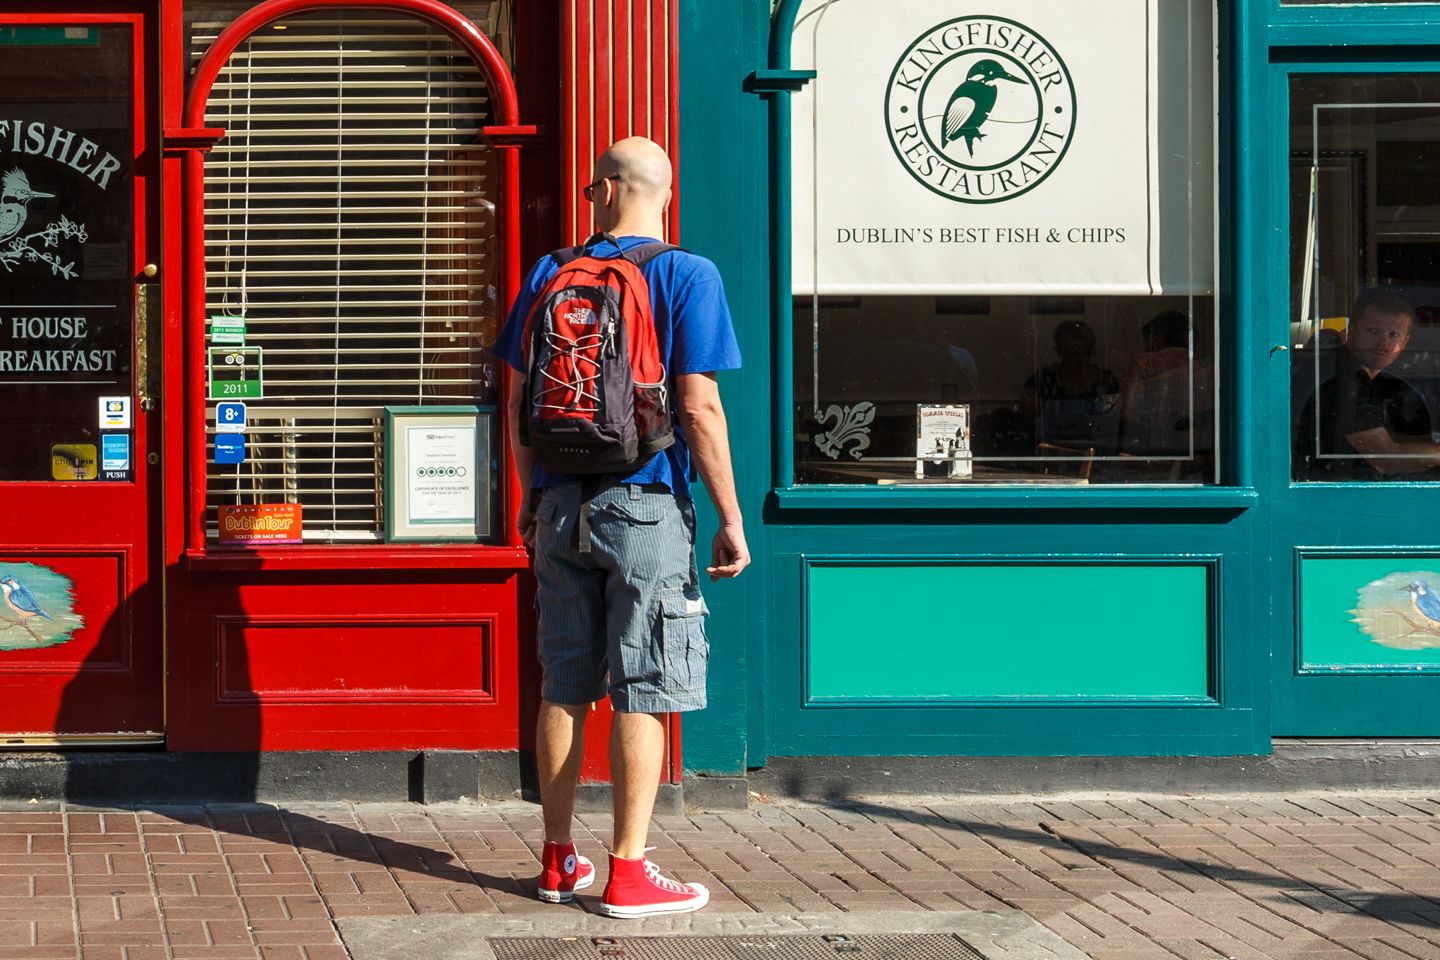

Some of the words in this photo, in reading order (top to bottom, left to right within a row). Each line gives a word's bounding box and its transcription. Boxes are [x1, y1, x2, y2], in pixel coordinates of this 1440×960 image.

[896, 16, 1063, 93] KINGFISHER
[895, 123, 1065, 197] RESTAURANT
[836, 227, 933, 243] DUBLIN'S
[939, 227, 990, 243] BEST
[996, 227, 1040, 243] FISH
[1046, 227, 1061, 243] &
[1066, 227, 1126, 243] CHIPS
[12, 317, 87, 339] HOUSE
[223, 384, 248, 394] 2011
